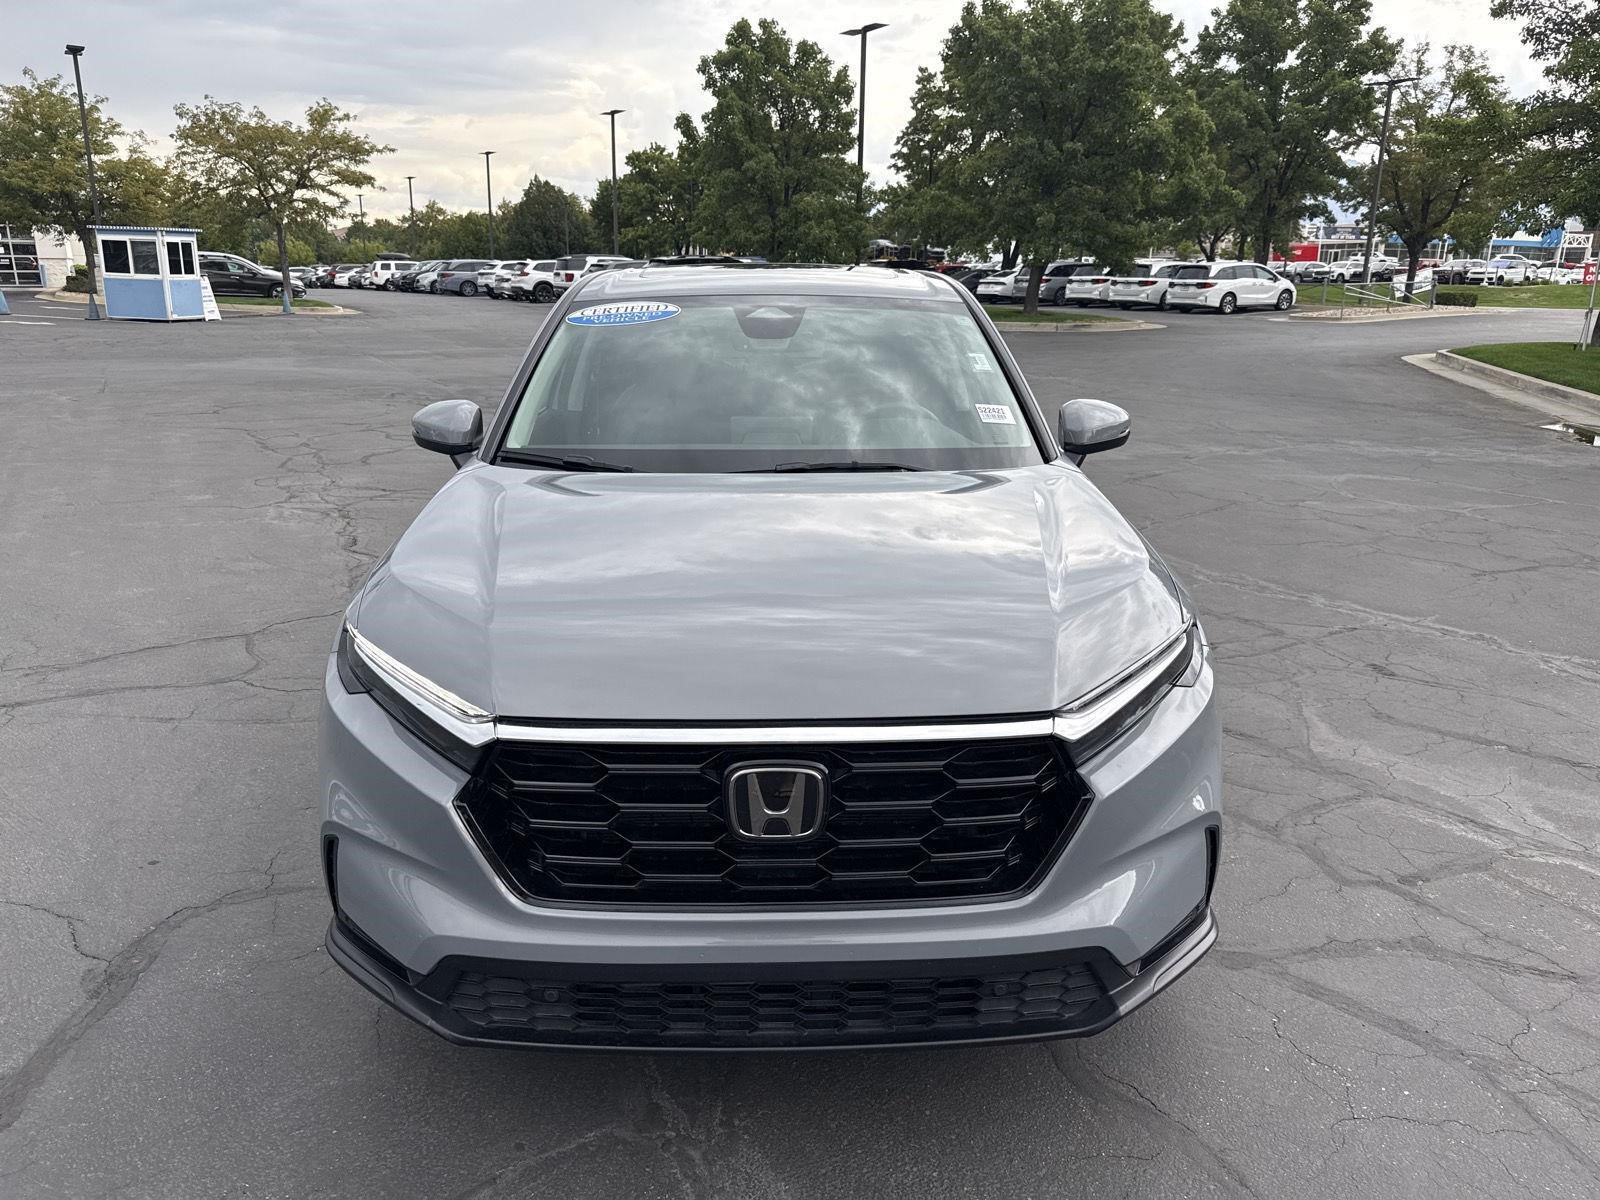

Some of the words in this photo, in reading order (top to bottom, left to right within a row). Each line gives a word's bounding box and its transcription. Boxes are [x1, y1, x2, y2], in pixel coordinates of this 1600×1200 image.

[581, 304, 668, 316] CERTIFIED
[583, 311, 662, 321] PRE-OWNED
[594, 315, 649, 323] VEHICLE
